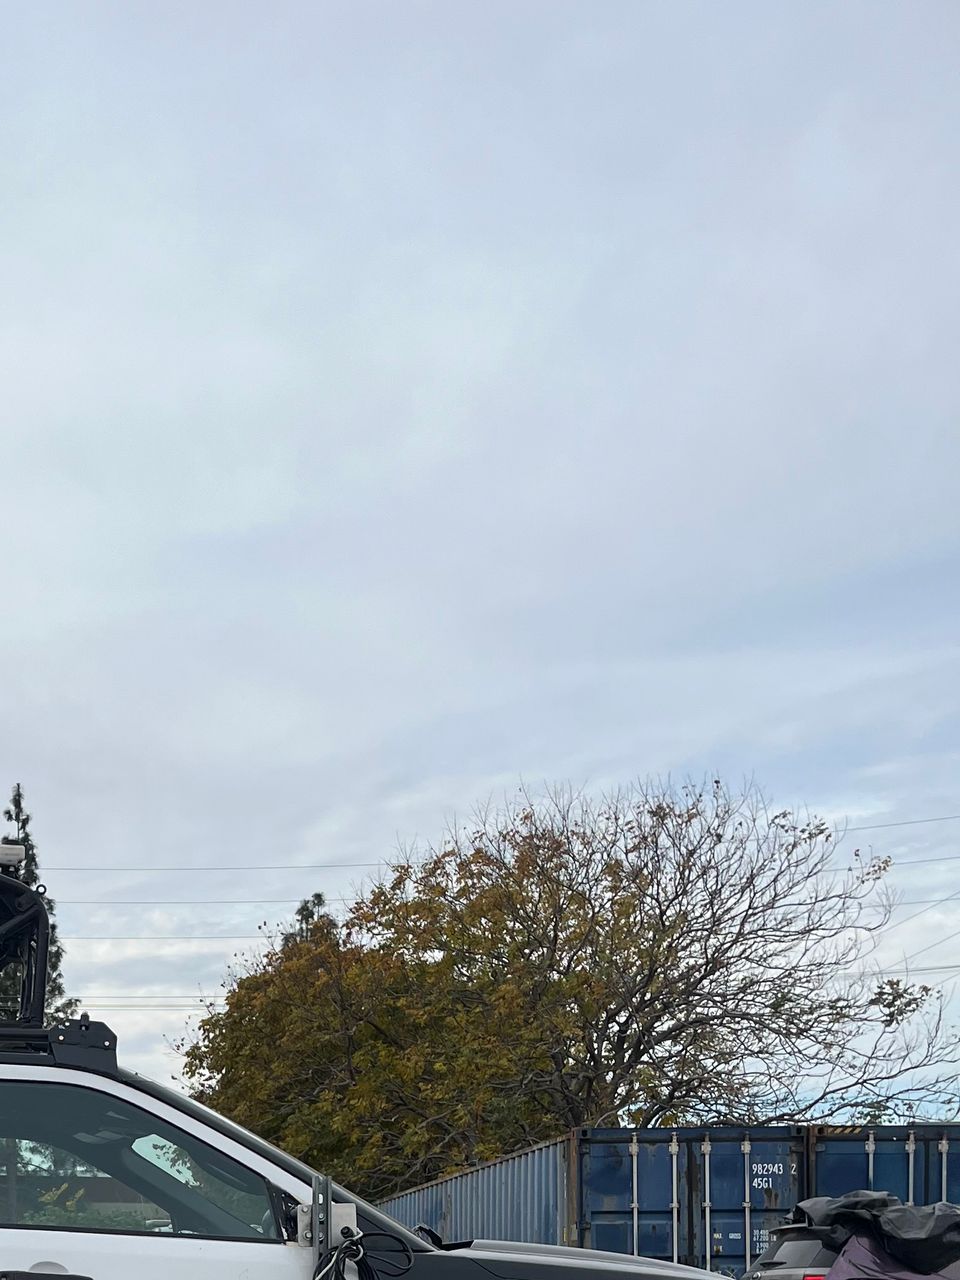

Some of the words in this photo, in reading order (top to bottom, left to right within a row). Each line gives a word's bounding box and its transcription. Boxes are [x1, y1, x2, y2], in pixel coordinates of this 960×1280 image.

[751, 1163, 784, 1175] 982943
[791, 1163, 797, 1175] 2
[752, 1177, 772, 1189] 45G1
